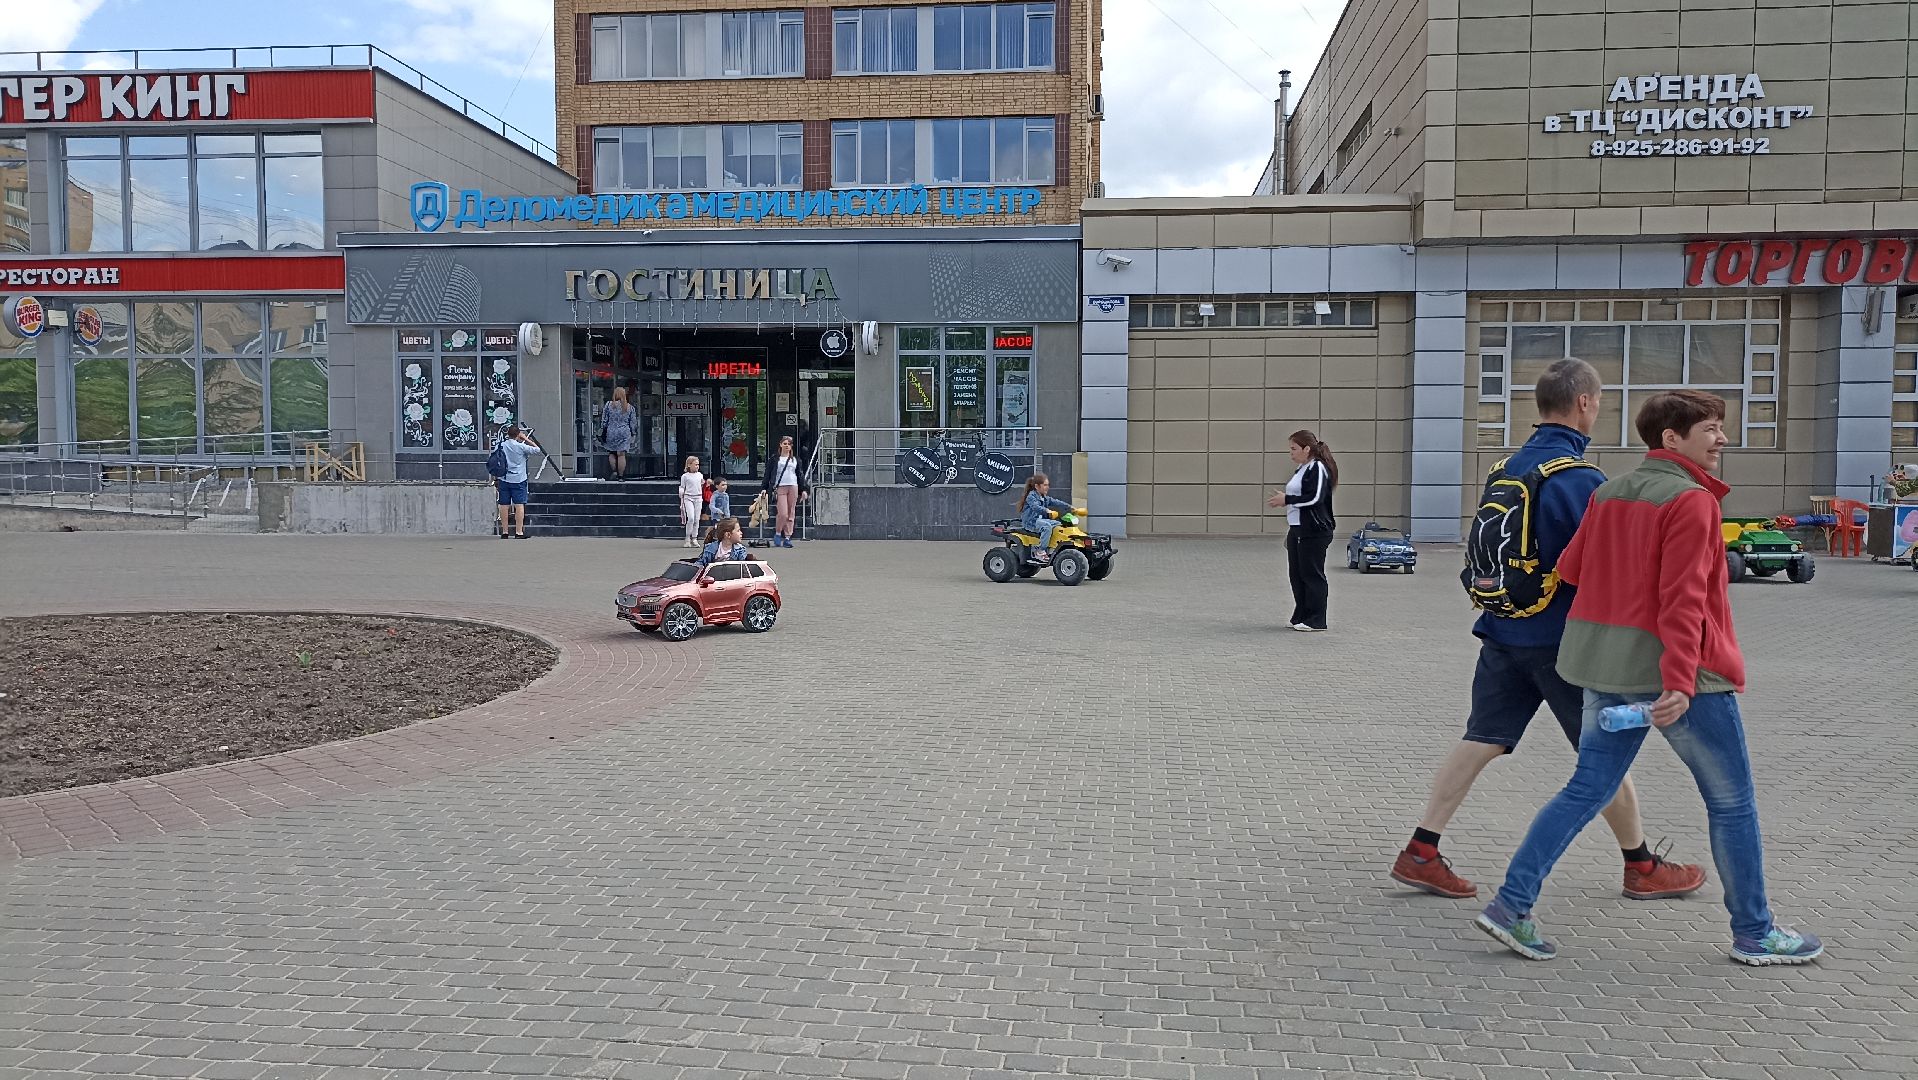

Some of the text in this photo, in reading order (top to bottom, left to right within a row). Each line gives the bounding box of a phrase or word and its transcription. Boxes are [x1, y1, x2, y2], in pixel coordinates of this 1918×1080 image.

[1608, 72, 1765, 105] АРЕНДА
[99, 74, 246, 119] КИНГ
[1570, 109, 1616, 135] ТЦ
[1590, 137, 1770, 156] 8-925-286-91-92
[454, 183, 1042, 228] Деломедика МЕДИЦИНСКИЙ ЦЕНТР
[564, 267, 840, 307] ГОСТИНИЦА
[17, 304, 41, 316] BURGER
[18, 311, 42, 326] KING
[402, 336, 431, 345] ЦВЕТЫ
[485, 336, 514, 345] ЦВЕТЫ
[447, 364, 473, 374] Floral
[708, 362, 761, 377] ЦВЕТЫ
[443, 374, 476, 383] company
[675, 403, 706, 411] ЦВЕТЫ
[977, 471, 1006, 487] СКИДКИ
